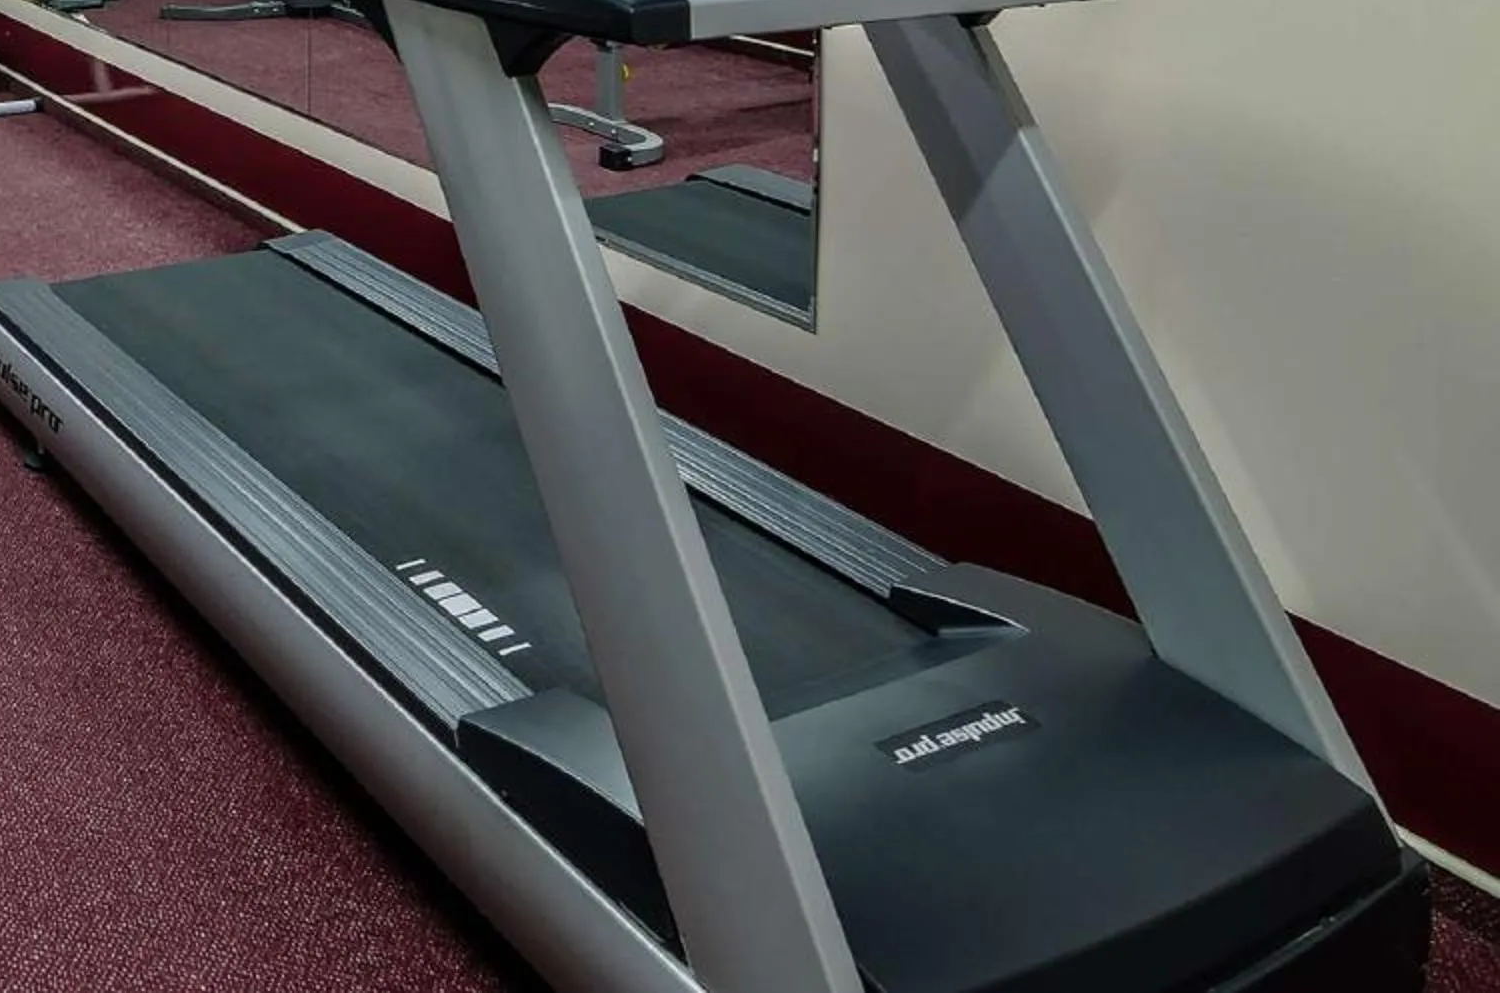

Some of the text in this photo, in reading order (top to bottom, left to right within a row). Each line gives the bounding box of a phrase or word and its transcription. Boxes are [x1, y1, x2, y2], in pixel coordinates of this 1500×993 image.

[30, 393, 64, 434] pro
[893, 707, 1026, 764] impulse pro
